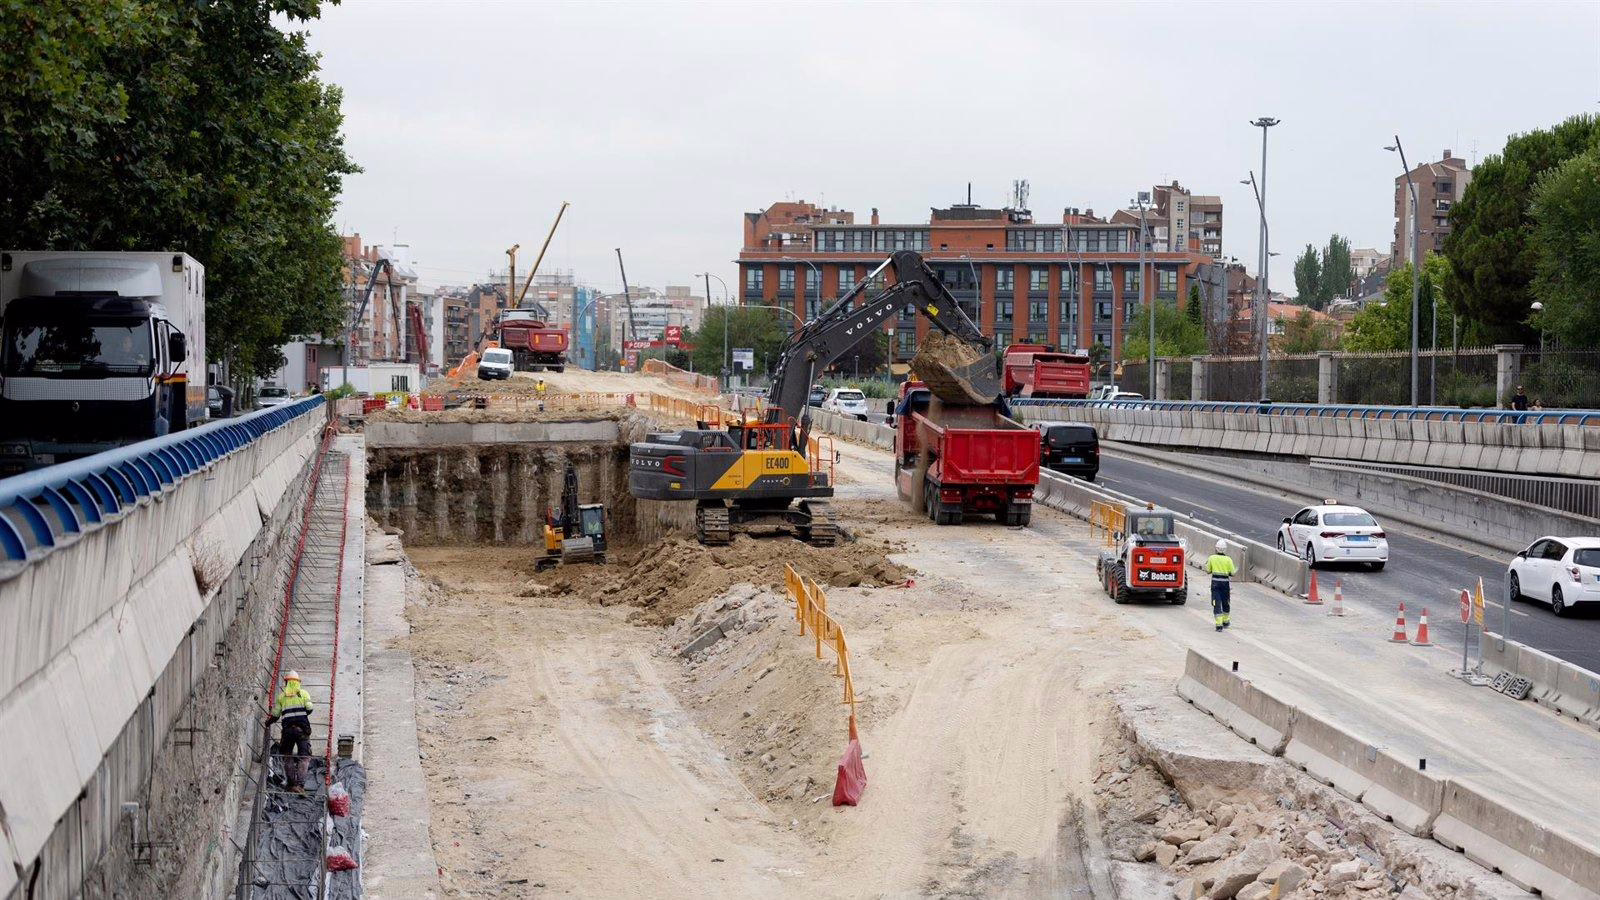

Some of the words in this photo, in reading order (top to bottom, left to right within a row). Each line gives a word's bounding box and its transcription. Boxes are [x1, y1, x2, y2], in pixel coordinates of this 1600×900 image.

[845, 303, 893, 335] VOLVO
[631, 459, 660, 467] VOLVO
[766, 457, 790, 470] EC400
[1151, 572, 1176, 581] Bobcat
